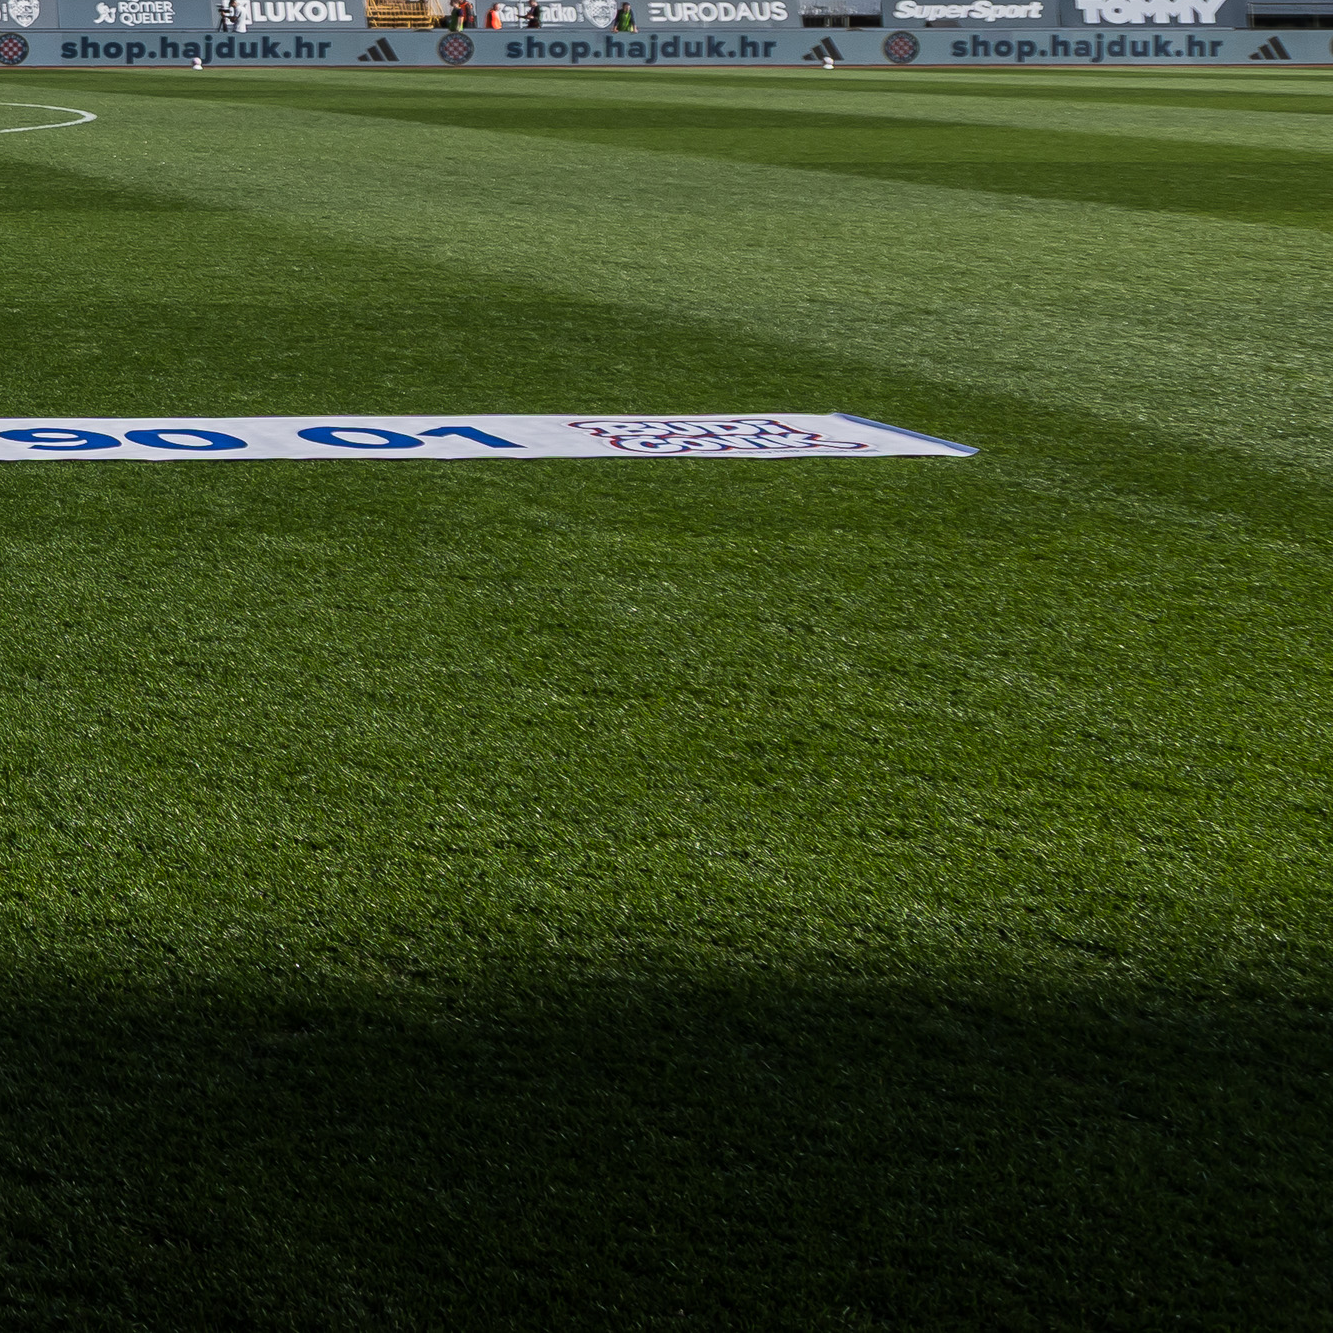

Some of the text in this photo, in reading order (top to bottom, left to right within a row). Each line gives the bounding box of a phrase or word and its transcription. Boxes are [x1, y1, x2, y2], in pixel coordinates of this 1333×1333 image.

[120, 13, 174, 26] QUELLE
[251, 0, 353, 23] LUKOIL
[648, 1, 789, 23] EURODAUS
[893, 0, 1044, 22] SuperSport
[60, 35, 331, 64] shop.hajduk.hr
[506, 35, 776, 64] shop.hajduk.hr
[951, 33, 1224, 63] shop.hajduk.hr
[296, 425, 531, 450] 01
